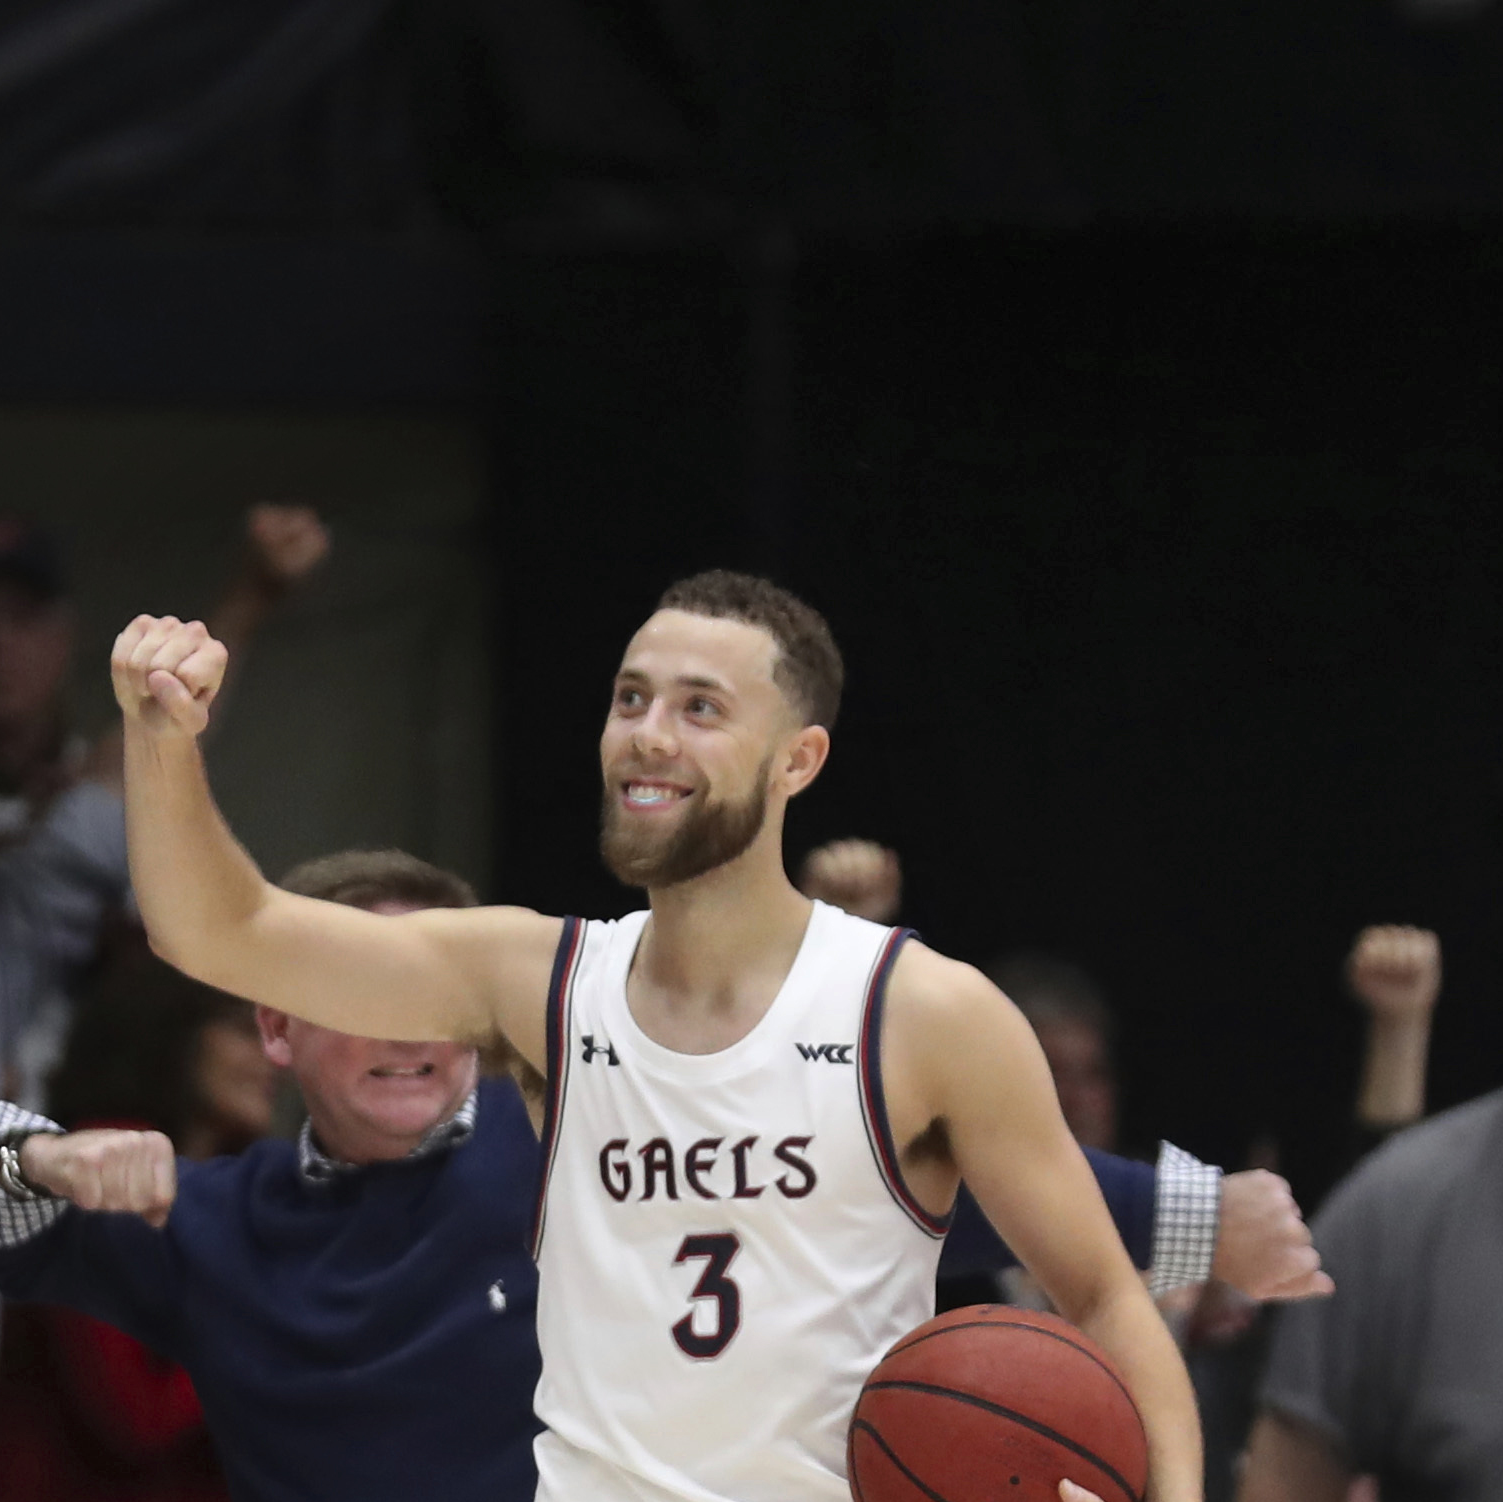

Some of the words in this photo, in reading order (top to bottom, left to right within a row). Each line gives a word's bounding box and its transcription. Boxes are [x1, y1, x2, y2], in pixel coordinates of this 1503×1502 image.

[795, 1042, 855, 1064] WCC
[599, 1135, 817, 1202] GAELS
[670, 1231, 743, 1362] 3
